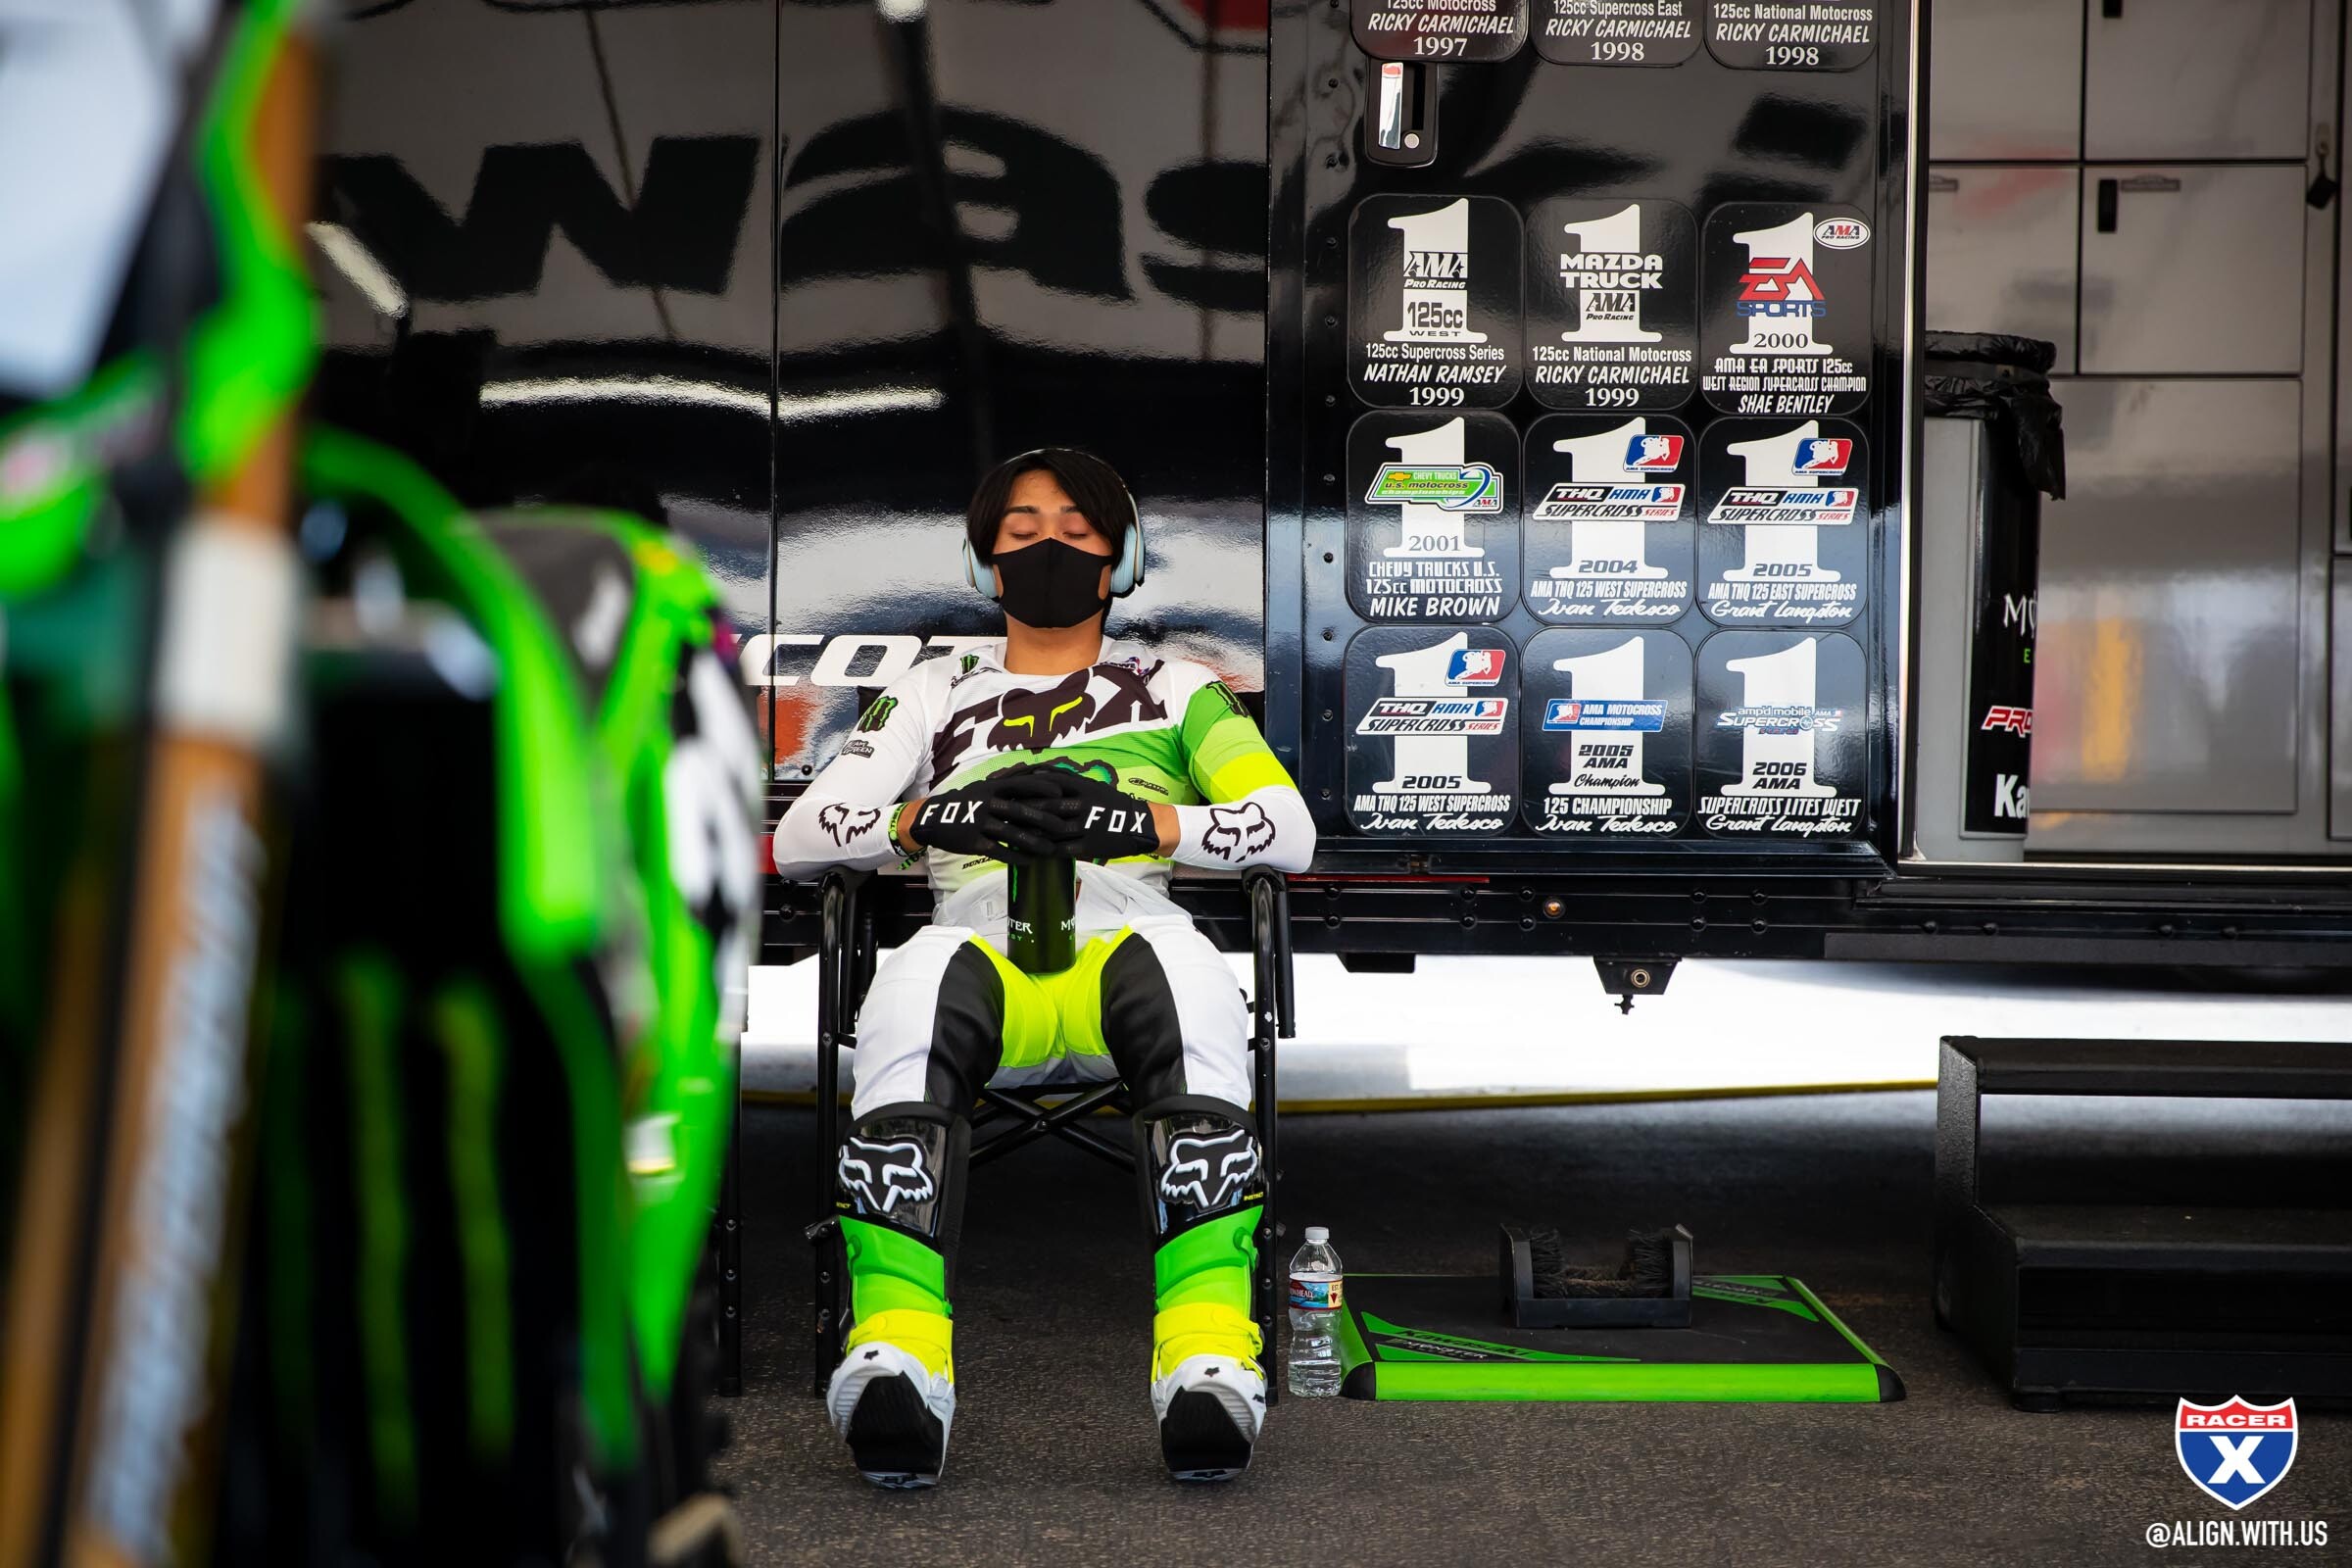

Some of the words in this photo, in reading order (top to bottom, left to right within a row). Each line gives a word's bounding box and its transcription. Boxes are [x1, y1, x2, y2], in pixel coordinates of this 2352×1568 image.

[1429, 0, 1496, 12] Motocross
[1553, 0, 1586, 15] 125cc
[1591, 0, 1655, 20] Supercross
[1658, 1, 1682, 16] East
[1714, 4, 1750, 19] 125cc
[1755, 4, 1805, 20] National
[1810, 5, 1872, 21] Motocross
[1368, 14, 1418, 31] RICKY
[1418, 16, 1514, 34] CARMICHAEL
[1545, 19, 1593, 37] RICKY
[1594, 20, 1691, 38] CARMICHAEL
[1716, 23, 1766, 41] RICKY
[1769, 24, 1870, 43] CARMICHAEL
[1413, 37, 1467, 56] 1997
[1591, 41, 1644, 60] 1998
[1766, 46, 1819, 65] 1998
[1822, 225, 1859, 235] AMA
[1384, 198, 1488, 343] 1
[1403, 252, 1468, 278] AMA
[1560, 254, 1662, 270] MAZDA
[1560, 272, 1663, 288] TRUCK
[1561, 204, 1662, 342] 1
[1427, 279, 1465, 289] RACING
[1730, 213, 1833, 354] 1
[1586, 293, 1635, 312] AMA
[1737, 301, 1827, 317] SPORTS
[1407, 301, 1463, 328] 125cc
[1753, 333, 1808, 348] 2000
[1366, 343, 1397, 359] 125cc
[1401, 344, 1465, 363] Supercross
[1469, 345, 1504, 360] Series
[1533, 346, 1569, 361] 125cc
[1574, 347, 1625, 362] National
[1629, 347, 1691, 362] Motocross
[1364, 364, 1432, 383] NATHAN
[1436, 366, 1506, 384] RAMSEY
[1536, 365, 1585, 383] RICKY
[1588, 366, 1690, 384] CARMICHAEL
[1714, 358, 1744, 373] AMA
[1749, 358, 1767, 373] EA
[1772, 359, 1819, 373] SPORTS
[1823, 359, 1852, 373] 125cc
[1703, 376, 1726, 391] WEST
[1729, 376, 1760, 391] REGION
[1763, 376, 1818, 392] SUPERCROSS
[1821, 377, 1866, 392] CHAMPION
[1409, 387, 1464, 406] 1999
[1585, 388, 1640, 407] 1999
[1739, 394, 1773, 414] SHAE
[1776, 394, 1835, 414] BENTLEY
[1383, 416, 1485, 558] 1
[1556, 488, 1604, 501] THQ
[1608, 489, 1651, 500] AMA
[1549, 416, 1668, 578] 1
[1723, 420, 1840, 581] 1
[1731, 492, 1779, 505] THQ
[1783, 493, 1825, 504] AMA
[1537, 505, 1643, 516] SUPERCROSS
[1711, 509, 1817, 520] SUPERCROSS
[1409, 536, 1461, 552] 2001
[1369, 562, 1412, 577] CHEVY
[1416, 562, 1469, 577] TRUCKS
[1474, 562, 1499, 577] U.S.
[1579, 560, 1638, 573] 2004
[1753, 564, 1812, 576] 2005
[1366, 578, 1406, 595] 125cc
[1410, 578, 1502, 594] MOTOCROSS
[1531, 581, 1553, 597] AMA
[1554, 581, 1575, 599] THQ
[1576, 581, 1592, 597] 125
[1594, 581, 1624, 598] WEST
[1624, 581, 1687, 599] SUPERCROSS
[1708, 583, 1729, 600] AMA
[1731, 583, 1751, 601] THQ
[1752, 583, 1769, 600] 125
[1770, 583, 1794, 600] EAST
[1794, 583, 1857, 601] SUPERCROSS
[1370, 597, 1418, 616] MIKE
[1426, 596, 1499, 616] BROWN
[1600, 599, 1681, 616] Tedesco
[1711, 601, 1773, 617] Grant
[1774, 601, 1852, 623] Langston
[1372, 632, 1492, 793] 1
[1379, 703, 1428, 714] THQ
[1432, 704, 1474, 713] AMA
[1548, 636, 1665, 795] 1
[1583, 705, 1604, 715] AMA
[1606, 705, 1662, 715] MOTOCROSS
[1721, 637, 1837, 797] 1
[1359, 719, 1467, 731] SUPERCROSS
[1580, 717, 1634, 726] CHAMPIONSHIP
[1717, 712, 1840, 731] SUPERCROSS
[1578, 745, 1634, 756] 2005
[1583, 758, 1628, 768] AMA
[1752, 761, 1807, 775] 2006
[1401, 776, 1462, 789] 2005
[1574, 774, 1640, 789] Champion
[1752, 778, 1800, 790] AMA
[920, 802, 984, 824] FOX
[1353, 795, 1376, 811] AMA
[1378, 795, 1397, 813] THQ
[1398, 795, 1416, 811] 125
[1417, 795, 1446, 812] WEST
[1447, 795, 1510, 812] SUPERCROSS
[1544, 797, 1568, 814] 125
[1572, 798, 1672, 815] CHAMPIONSHIP
[1697, 797, 1784, 815] SUPERCROSS
[1784, 798, 1822, 815] LITES
[1822, 799, 1861, 816] WEST
[1085, 806, 1147, 833] FOX
[1423, 812, 1503, 830] Tedesco
[1597, 815, 1677, 832] Tedesco
[1705, 814, 1775, 831] Grant
[1771, 815, 1852, 838] Langston
